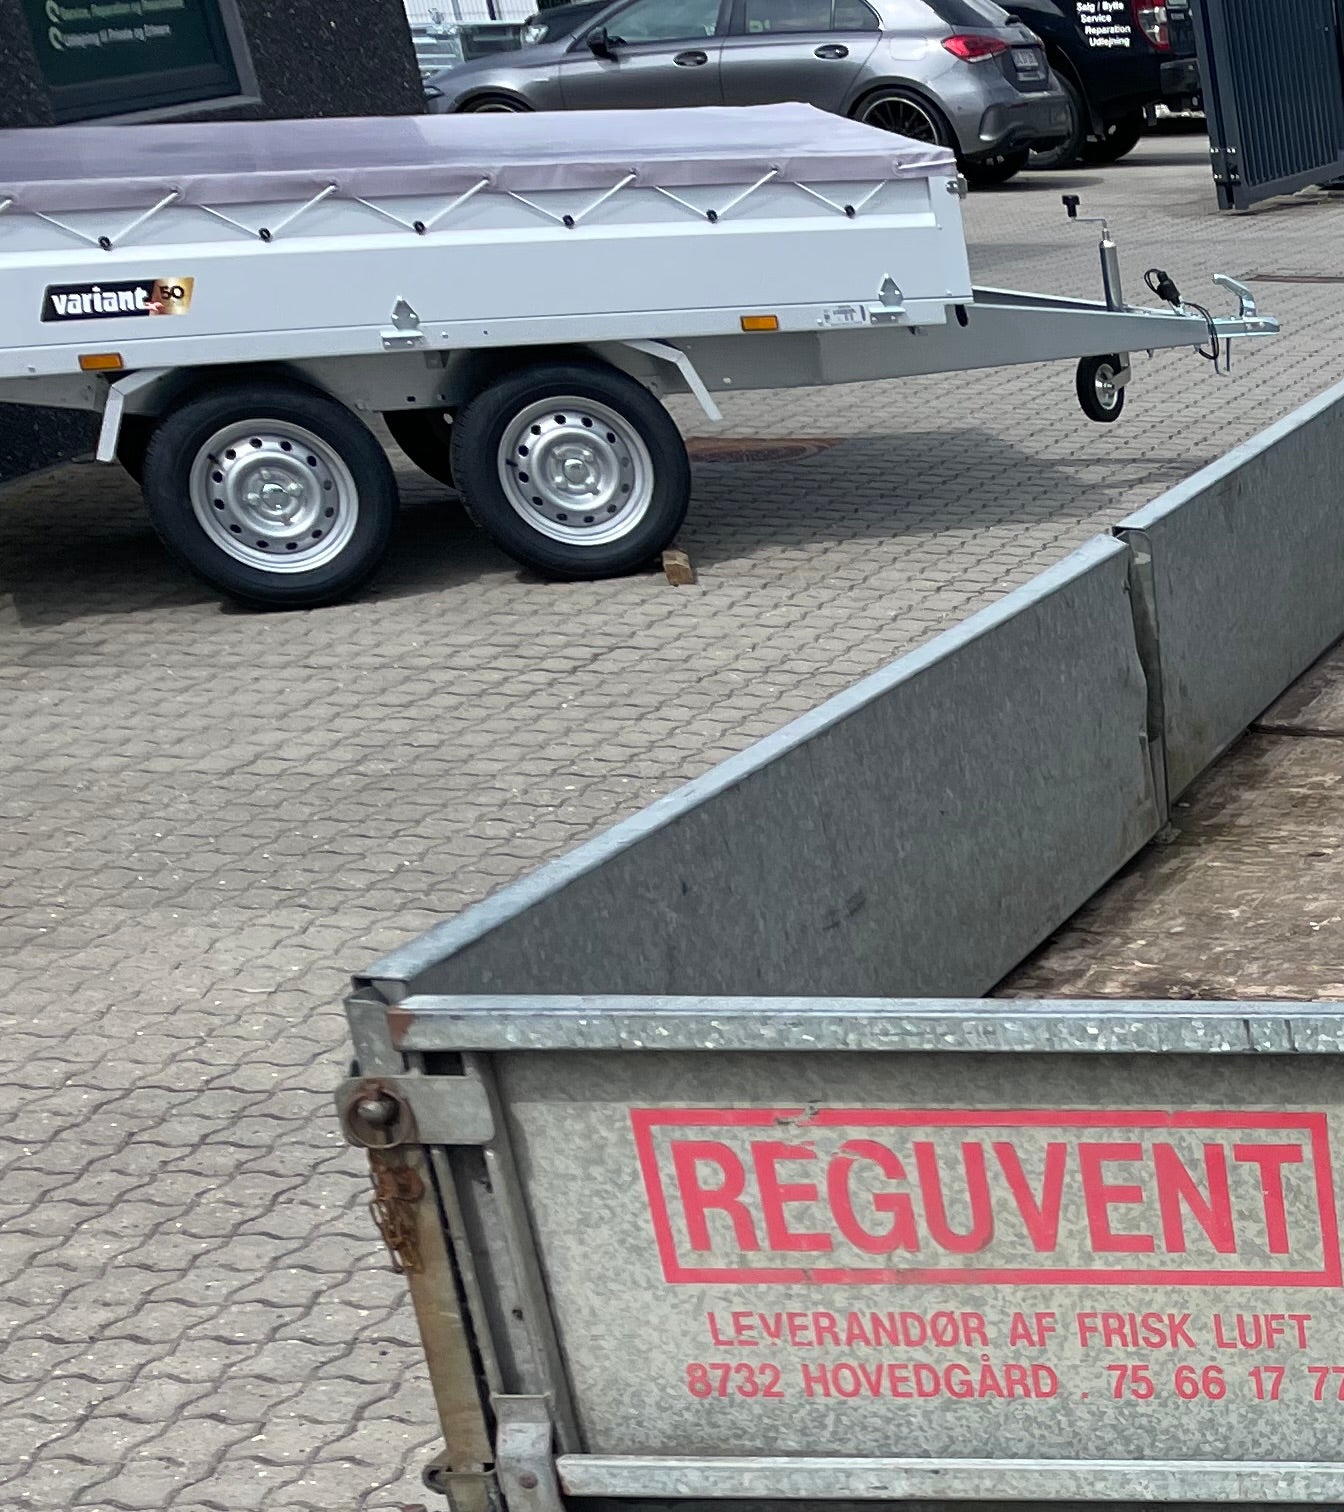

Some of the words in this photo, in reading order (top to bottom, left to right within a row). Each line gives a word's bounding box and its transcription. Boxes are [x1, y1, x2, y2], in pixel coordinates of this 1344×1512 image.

[1081, 14, 1112, 24] Service
[1085, 25, 1131, 36] Reparation
[1089, 37, 1130, 48] Udlejning
[51, 286, 149, 316] variant
[160, 285, 185, 300] 50
[669, 1139, 1304, 1256] REGUVENT
[707, 1311, 989, 1348] LEVERANDØR
[1009, 1311, 1056, 1348] AF
[1077, 1312, 1196, 1349] FRISK
[1214, 1313, 1312, 1350] LUFT
[685, 1362, 785, 1398] 8732
[802, 1355, 1059, 1399] HOVEDGÅRD
[1106, 1364, 1155, 1400] 75
[1174, 1364, 1227, 1400] 66
[1248, 1366, 1286, 1401] 17
